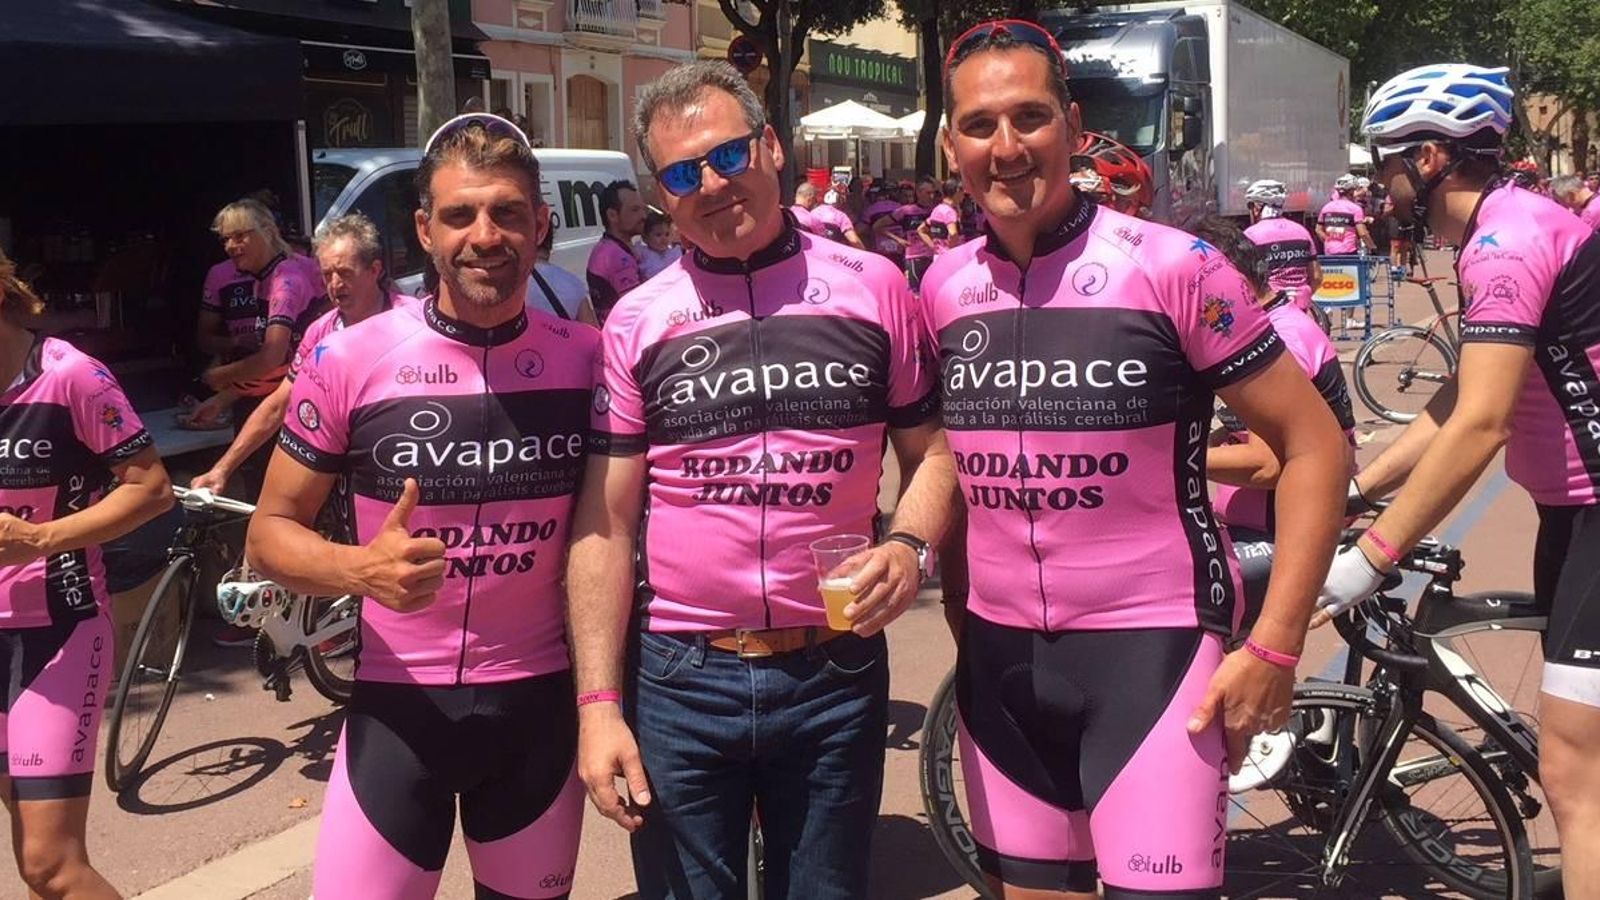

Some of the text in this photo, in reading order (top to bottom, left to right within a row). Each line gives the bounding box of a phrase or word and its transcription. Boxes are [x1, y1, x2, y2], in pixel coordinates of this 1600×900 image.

[828, 53, 904, 85] NOU TROPICAL
[672, 360, 872, 406] avapace
[950, 358, 1148, 397] avapace
[982, 412, 996, 425] la
[1075, 410, 1149, 426] cerebral
[1018, 396, 1117, 411] valenciana
[1126, 396, 1149, 409] de
[723, 420, 737, 435] la
[391, 433, 583, 475] avapace
[680, 448, 855, 478] RODANDO
[954, 451, 1130, 478] RODANDO
[376, 473, 476, 489] asoiación
[691, 482, 834, 508] JUNTOS
[969, 485, 1106, 511] JUNTOS
[1186, 420, 1226, 606] avapace
[411, 517, 558, 550] ODANDO
[445, 550, 537, 580] NTOS
[70, 635, 103, 763] avapace
